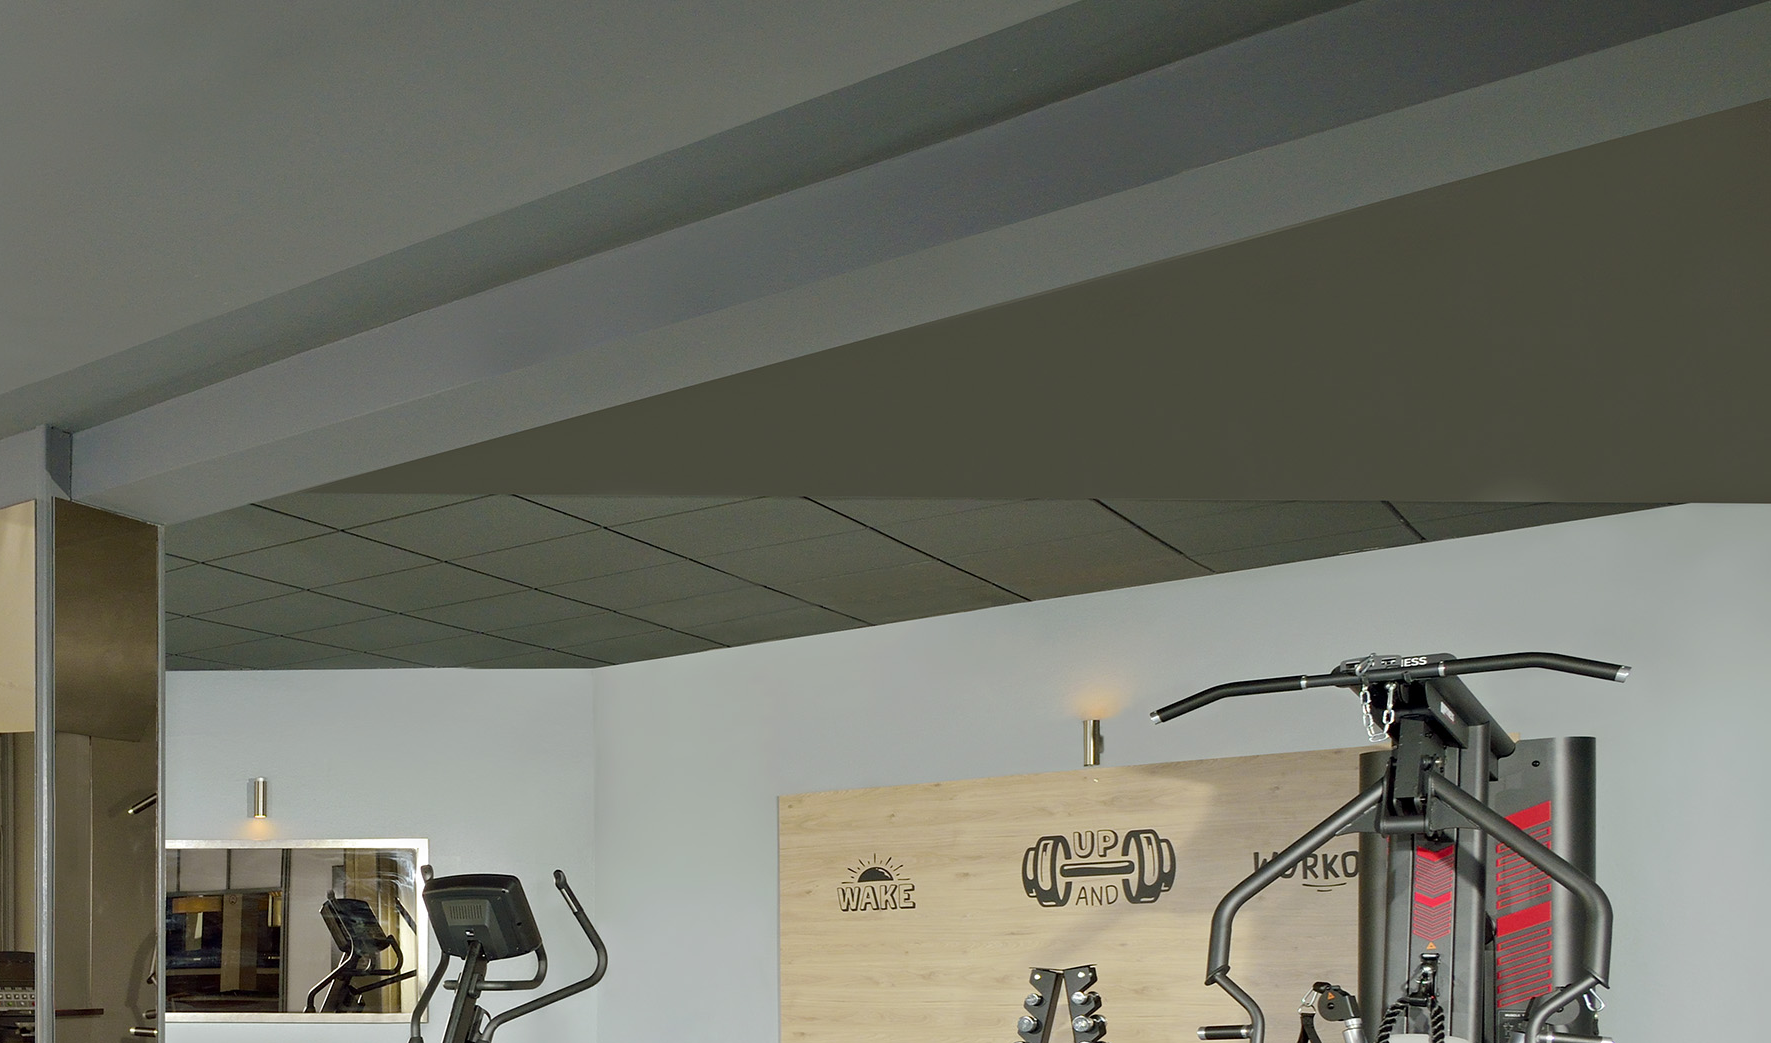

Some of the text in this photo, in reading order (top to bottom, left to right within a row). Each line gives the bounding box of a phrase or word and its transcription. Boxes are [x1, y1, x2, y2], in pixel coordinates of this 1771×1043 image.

[1072, 829, 1120, 859] UP
[836, 883, 916, 912] WAKE
[1075, 884, 1119, 906] AND
